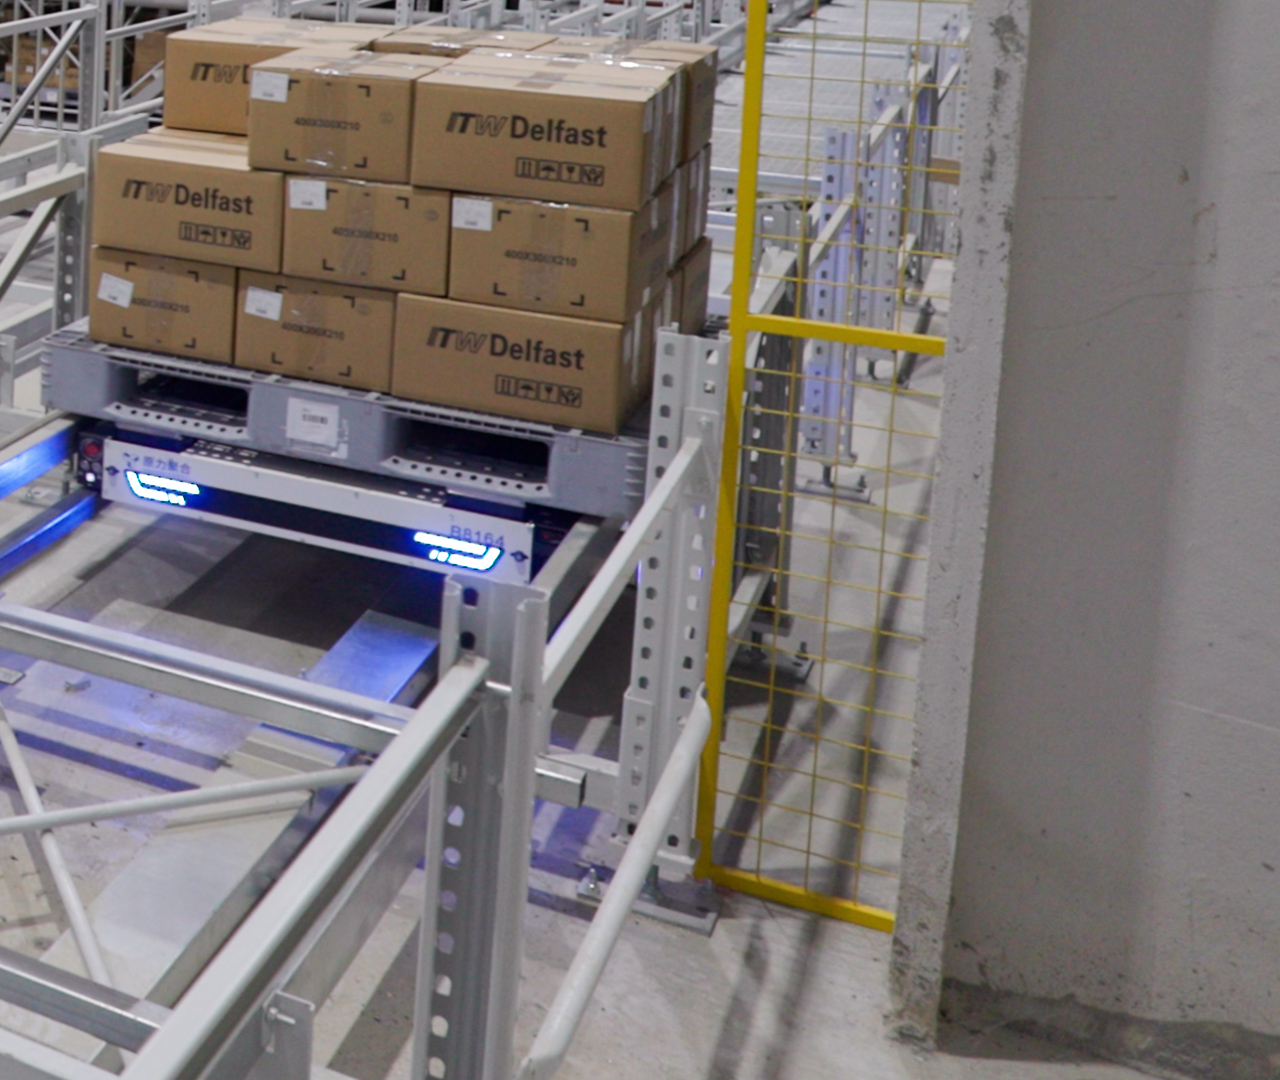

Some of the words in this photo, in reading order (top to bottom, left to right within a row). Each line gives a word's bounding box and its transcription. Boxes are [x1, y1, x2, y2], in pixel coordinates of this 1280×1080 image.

[190, 62, 241, 84] ITW
[445, 111, 508, 138] ITW
[510, 114, 608, 148] Delfast
[122, 178, 173, 203] ITW
[174, 183, 254, 215] Delfast
[503, 248, 578, 267] 400X300X210
[426, 326, 488, 353] ITW
[489, 332, 586, 370] Delfast
[450, 524, 505, 547] B8164
